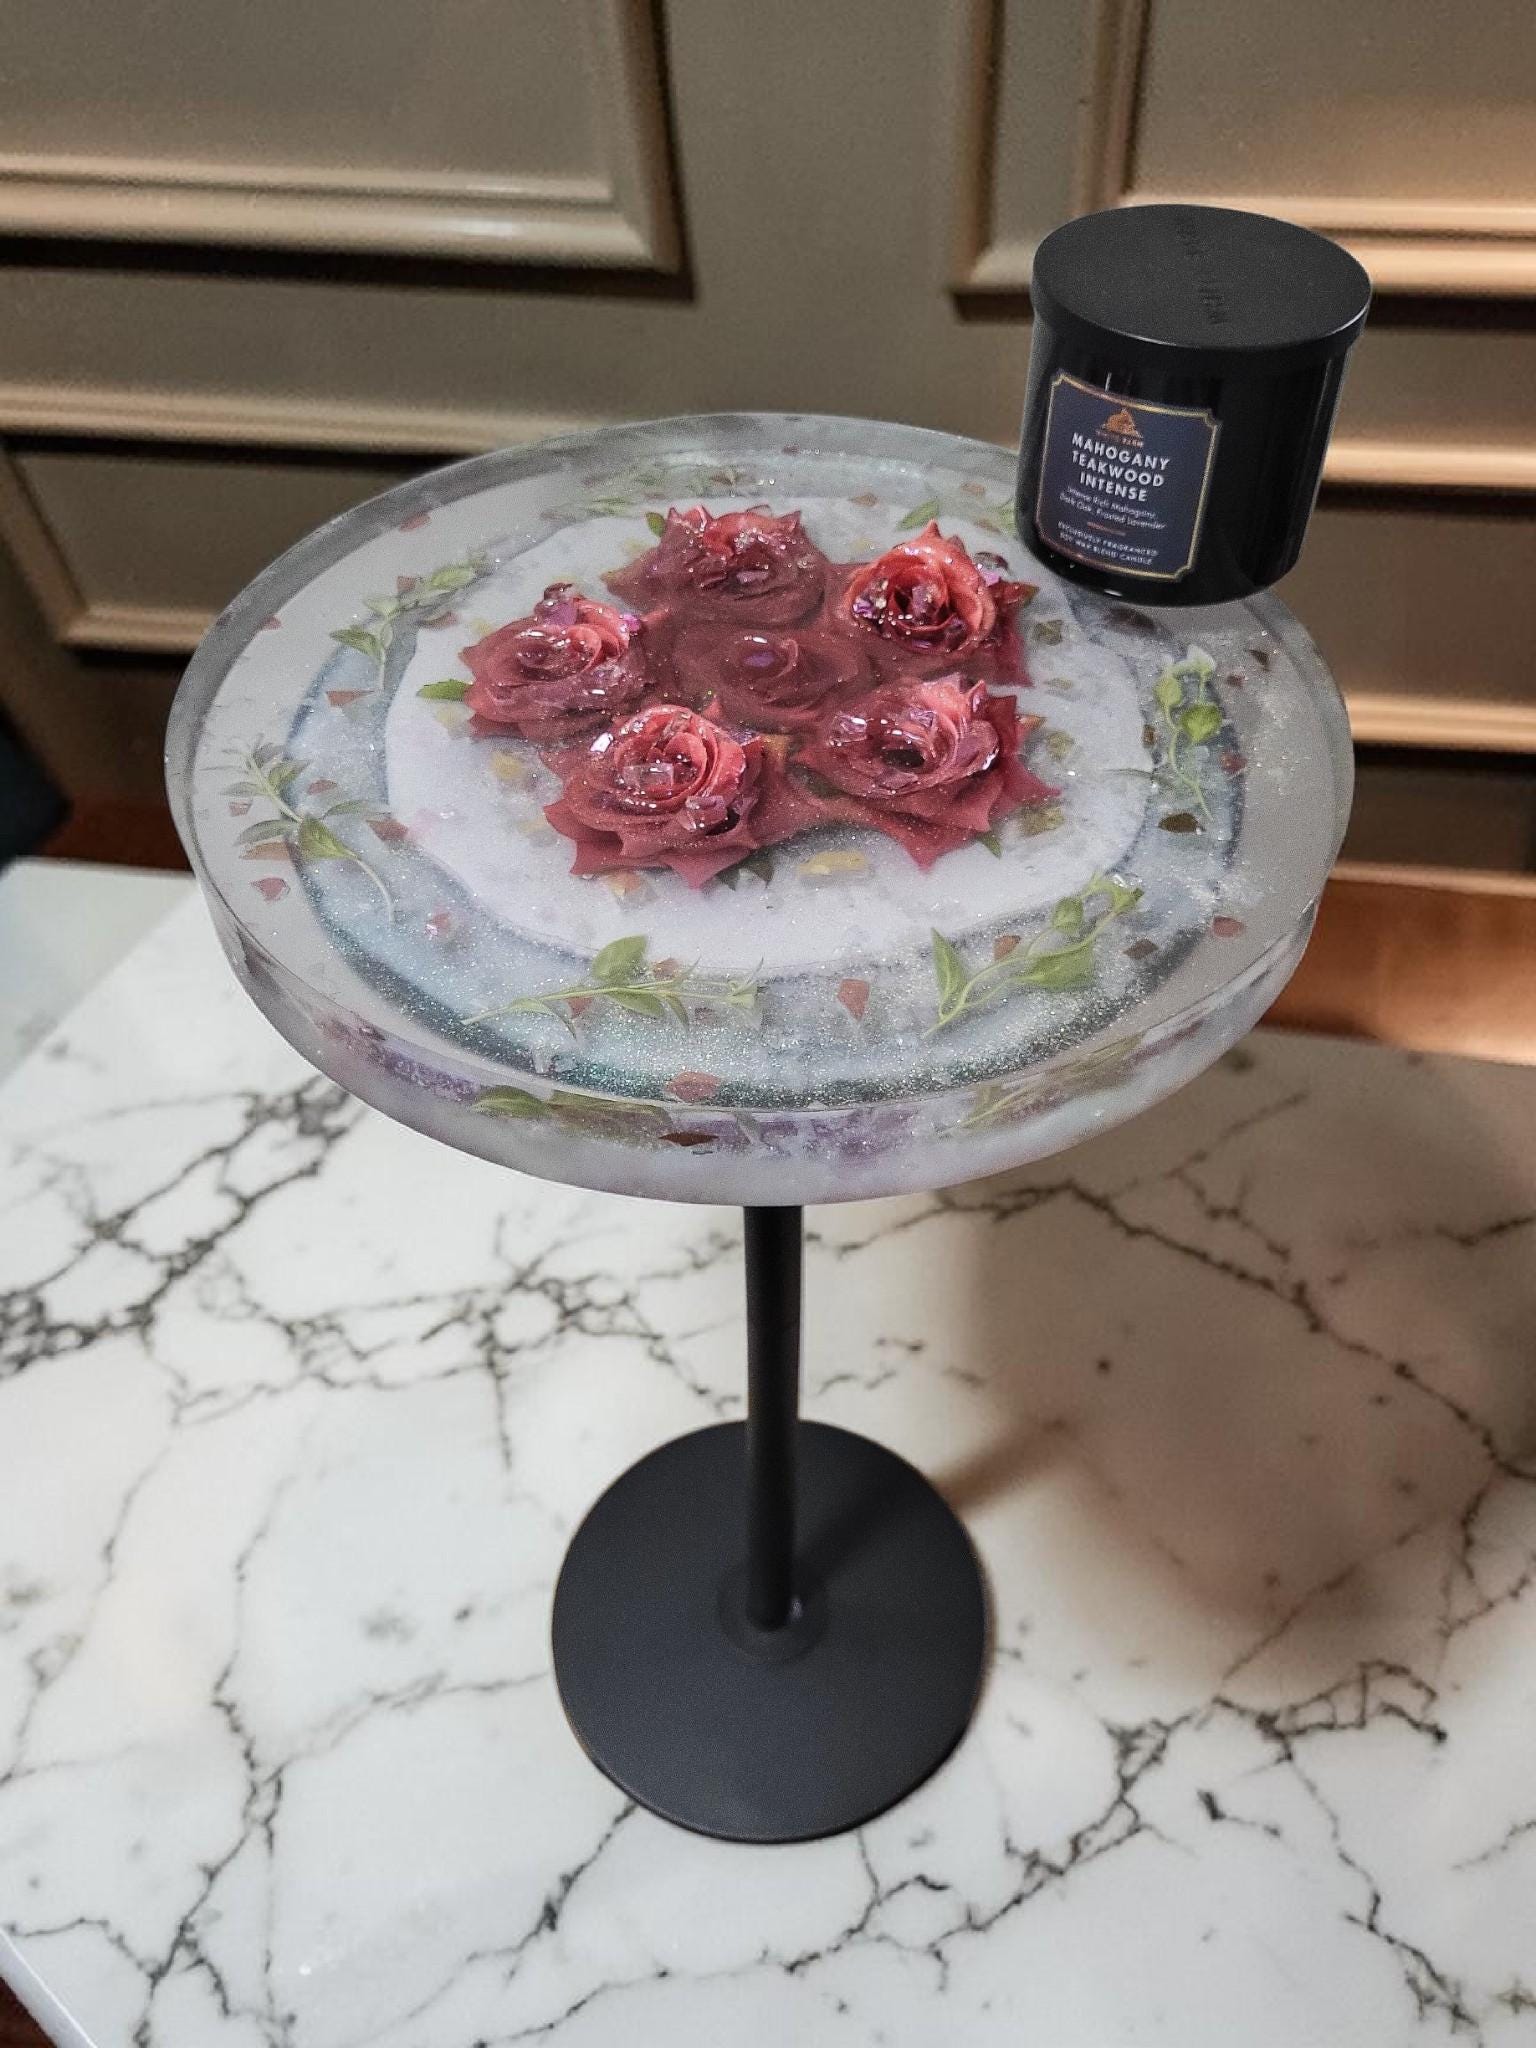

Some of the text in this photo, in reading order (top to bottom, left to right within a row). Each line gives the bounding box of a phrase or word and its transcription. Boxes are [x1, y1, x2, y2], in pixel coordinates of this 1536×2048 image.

[1072, 432, 1170, 471] MAHOGANY
[1072, 450, 1165, 487] TEAKWOOD
[1080, 472, 1148, 501] INTENSE
